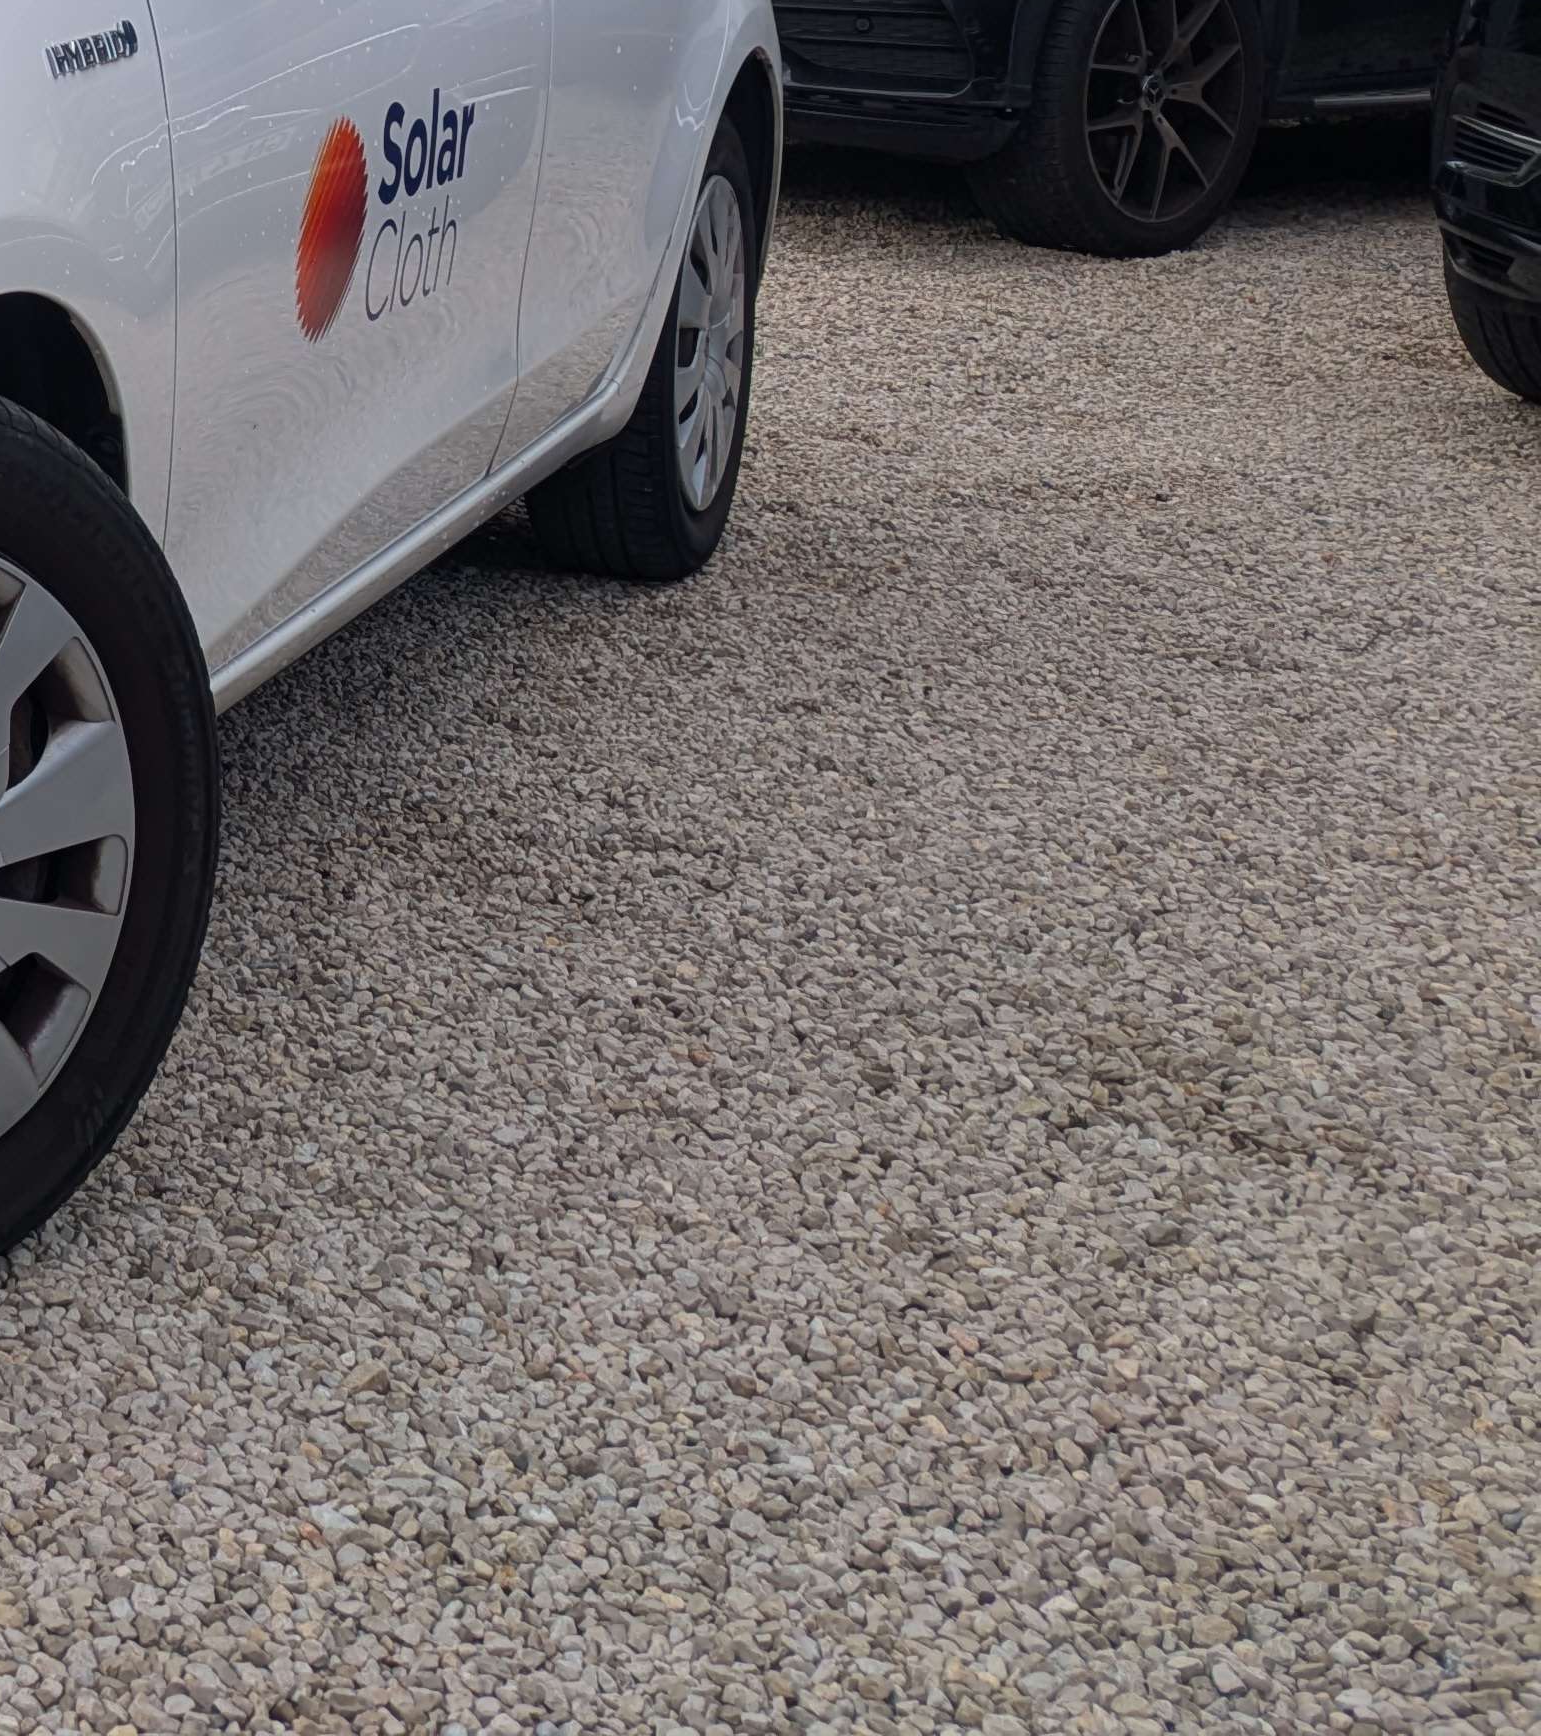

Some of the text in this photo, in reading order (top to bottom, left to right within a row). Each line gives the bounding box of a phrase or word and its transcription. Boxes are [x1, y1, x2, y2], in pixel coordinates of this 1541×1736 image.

[44, 29, 125, 79] HYBRID
[377, 87, 476, 205] Solar
[364, 194, 457, 322] Cloth
